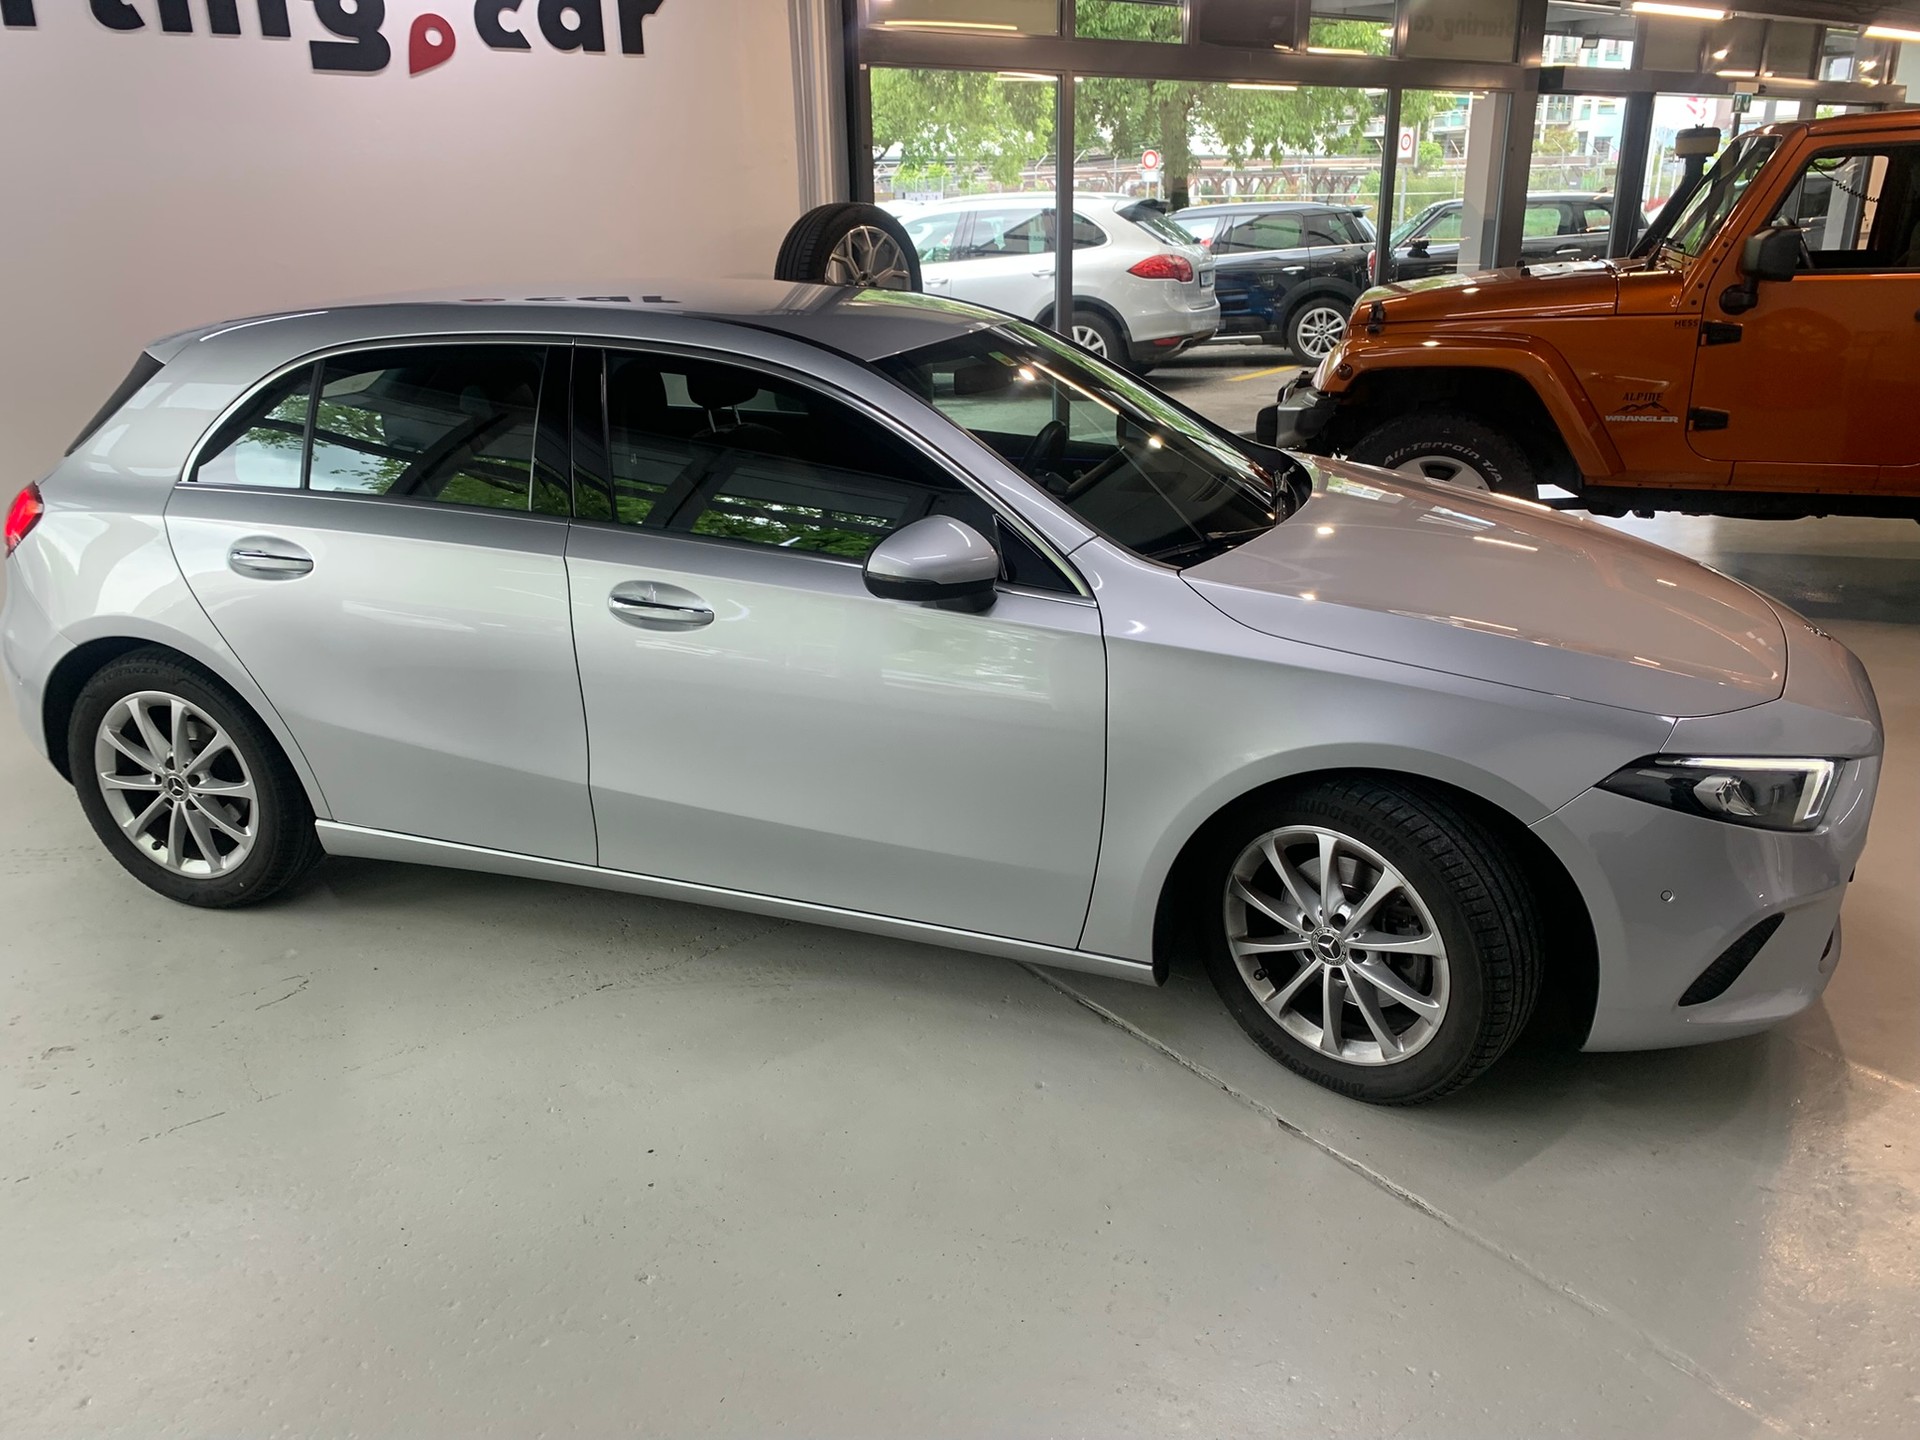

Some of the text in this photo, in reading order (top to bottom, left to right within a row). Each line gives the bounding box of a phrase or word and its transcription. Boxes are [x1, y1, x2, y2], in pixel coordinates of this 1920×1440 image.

[1674, 320, 1698, 328] HESS
[1623, 392, 1663, 402] ALPINE
[1605, 415, 1678, 424] WRANGLER
[1383, 441, 1504, 484] All-Terrain T/A
[102, 666, 159, 683] TURANZA
